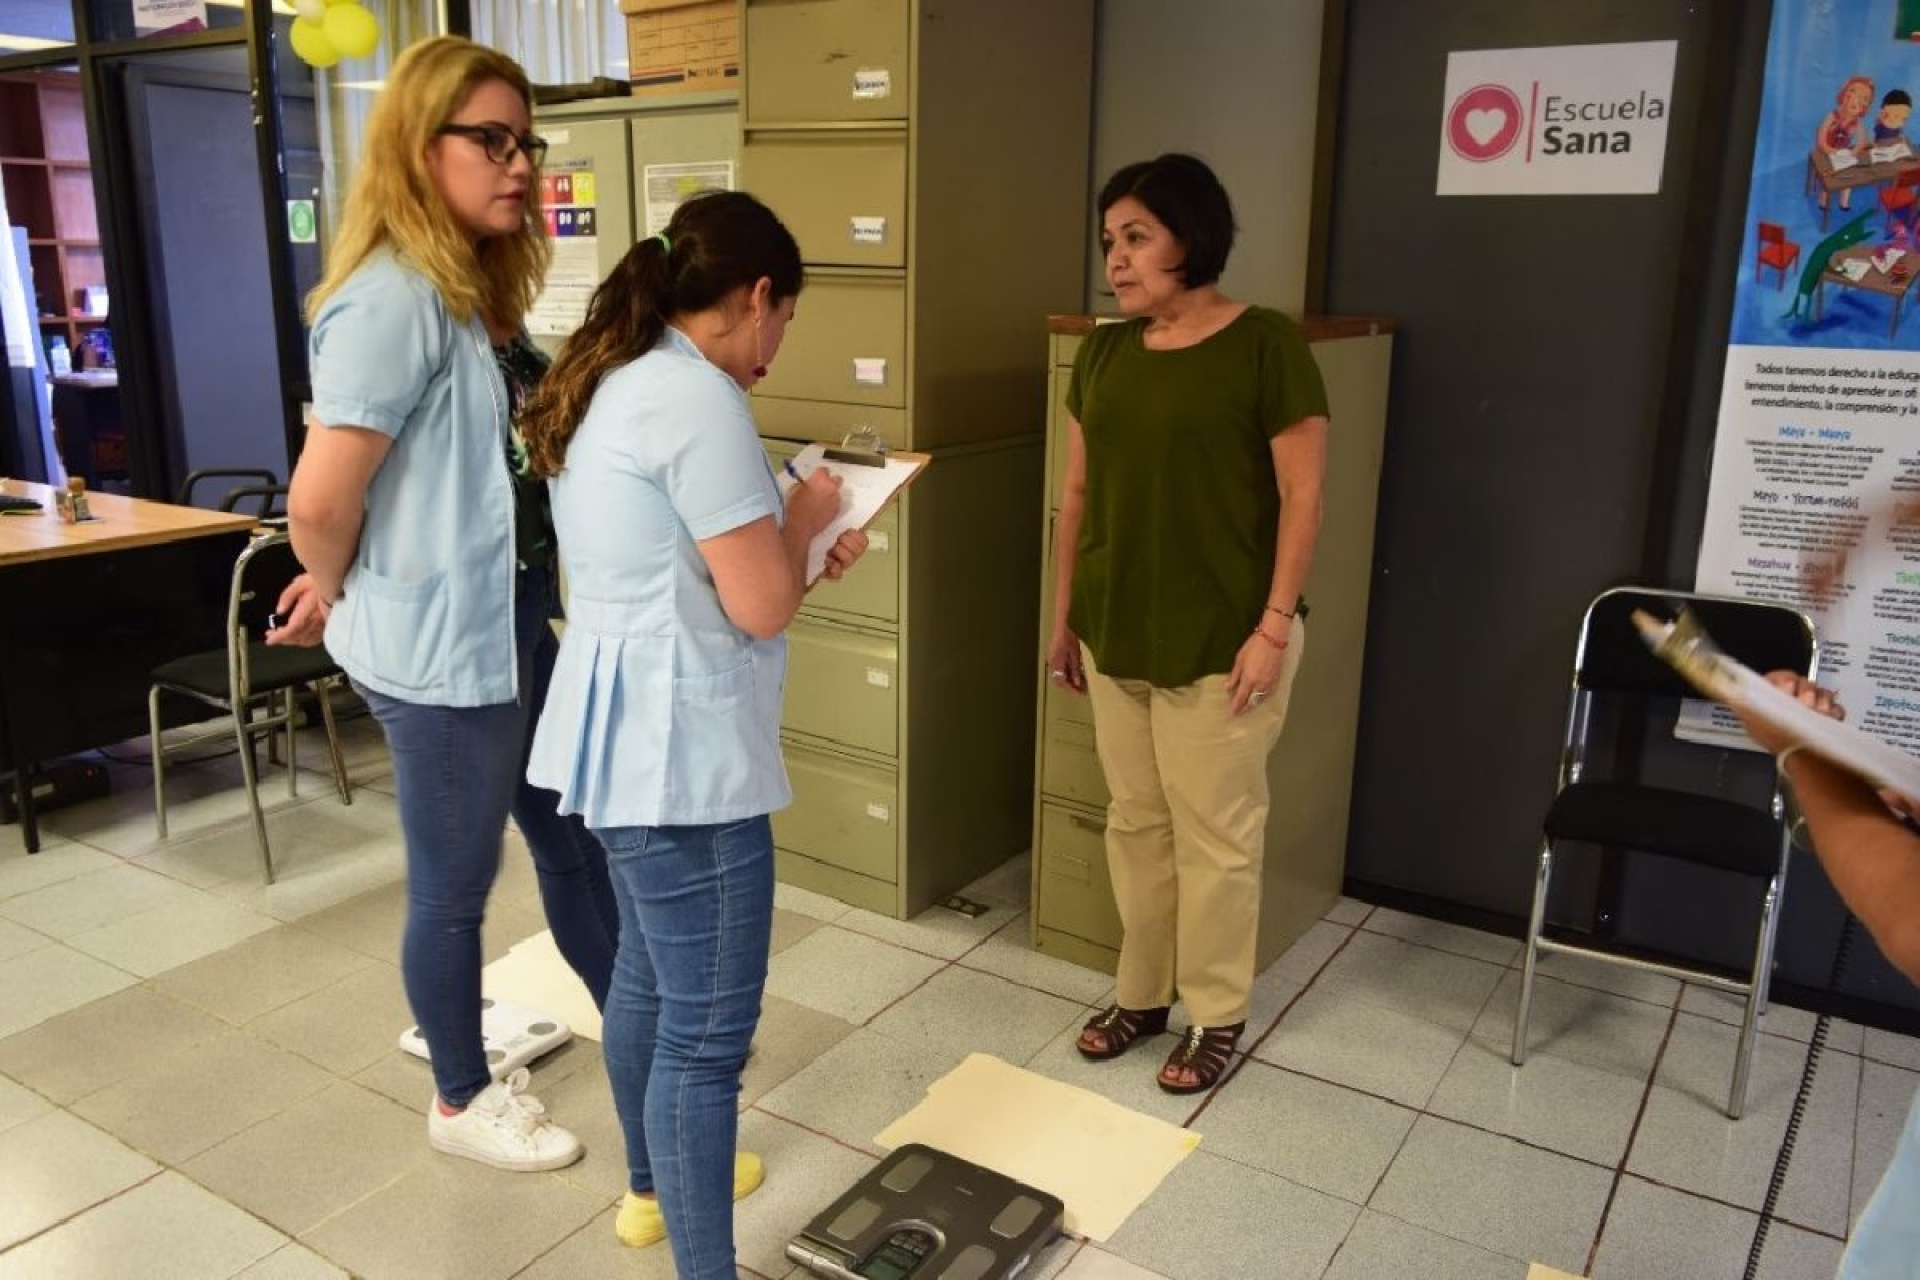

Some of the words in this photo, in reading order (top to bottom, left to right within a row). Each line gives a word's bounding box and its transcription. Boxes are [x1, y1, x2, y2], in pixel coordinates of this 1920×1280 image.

[1544, 90, 1664, 122] Escuela
[1543, 126, 1631, 155] Sana
[1756, 363, 1783, 375] Todos
[1785, 365, 1826, 377] tenemos
[1828, 365, 1868, 379] derecho
[1878, 368, 1886, 380] la
[1745, 380, 1785, 392] tenemos
[1787, 382, 1826, 394] derecho
[1827, 384, 1840, 395] de
[1841, 386, 1887, 398] aprender
[1888, 388, 1903, 397] un
[1751, 398, 1823, 411] entendimiento,
[1825, 399, 1833, 411] la
[1834, 401, 1899, 415] comprensión
[1909, 403, 1918, 415] la
